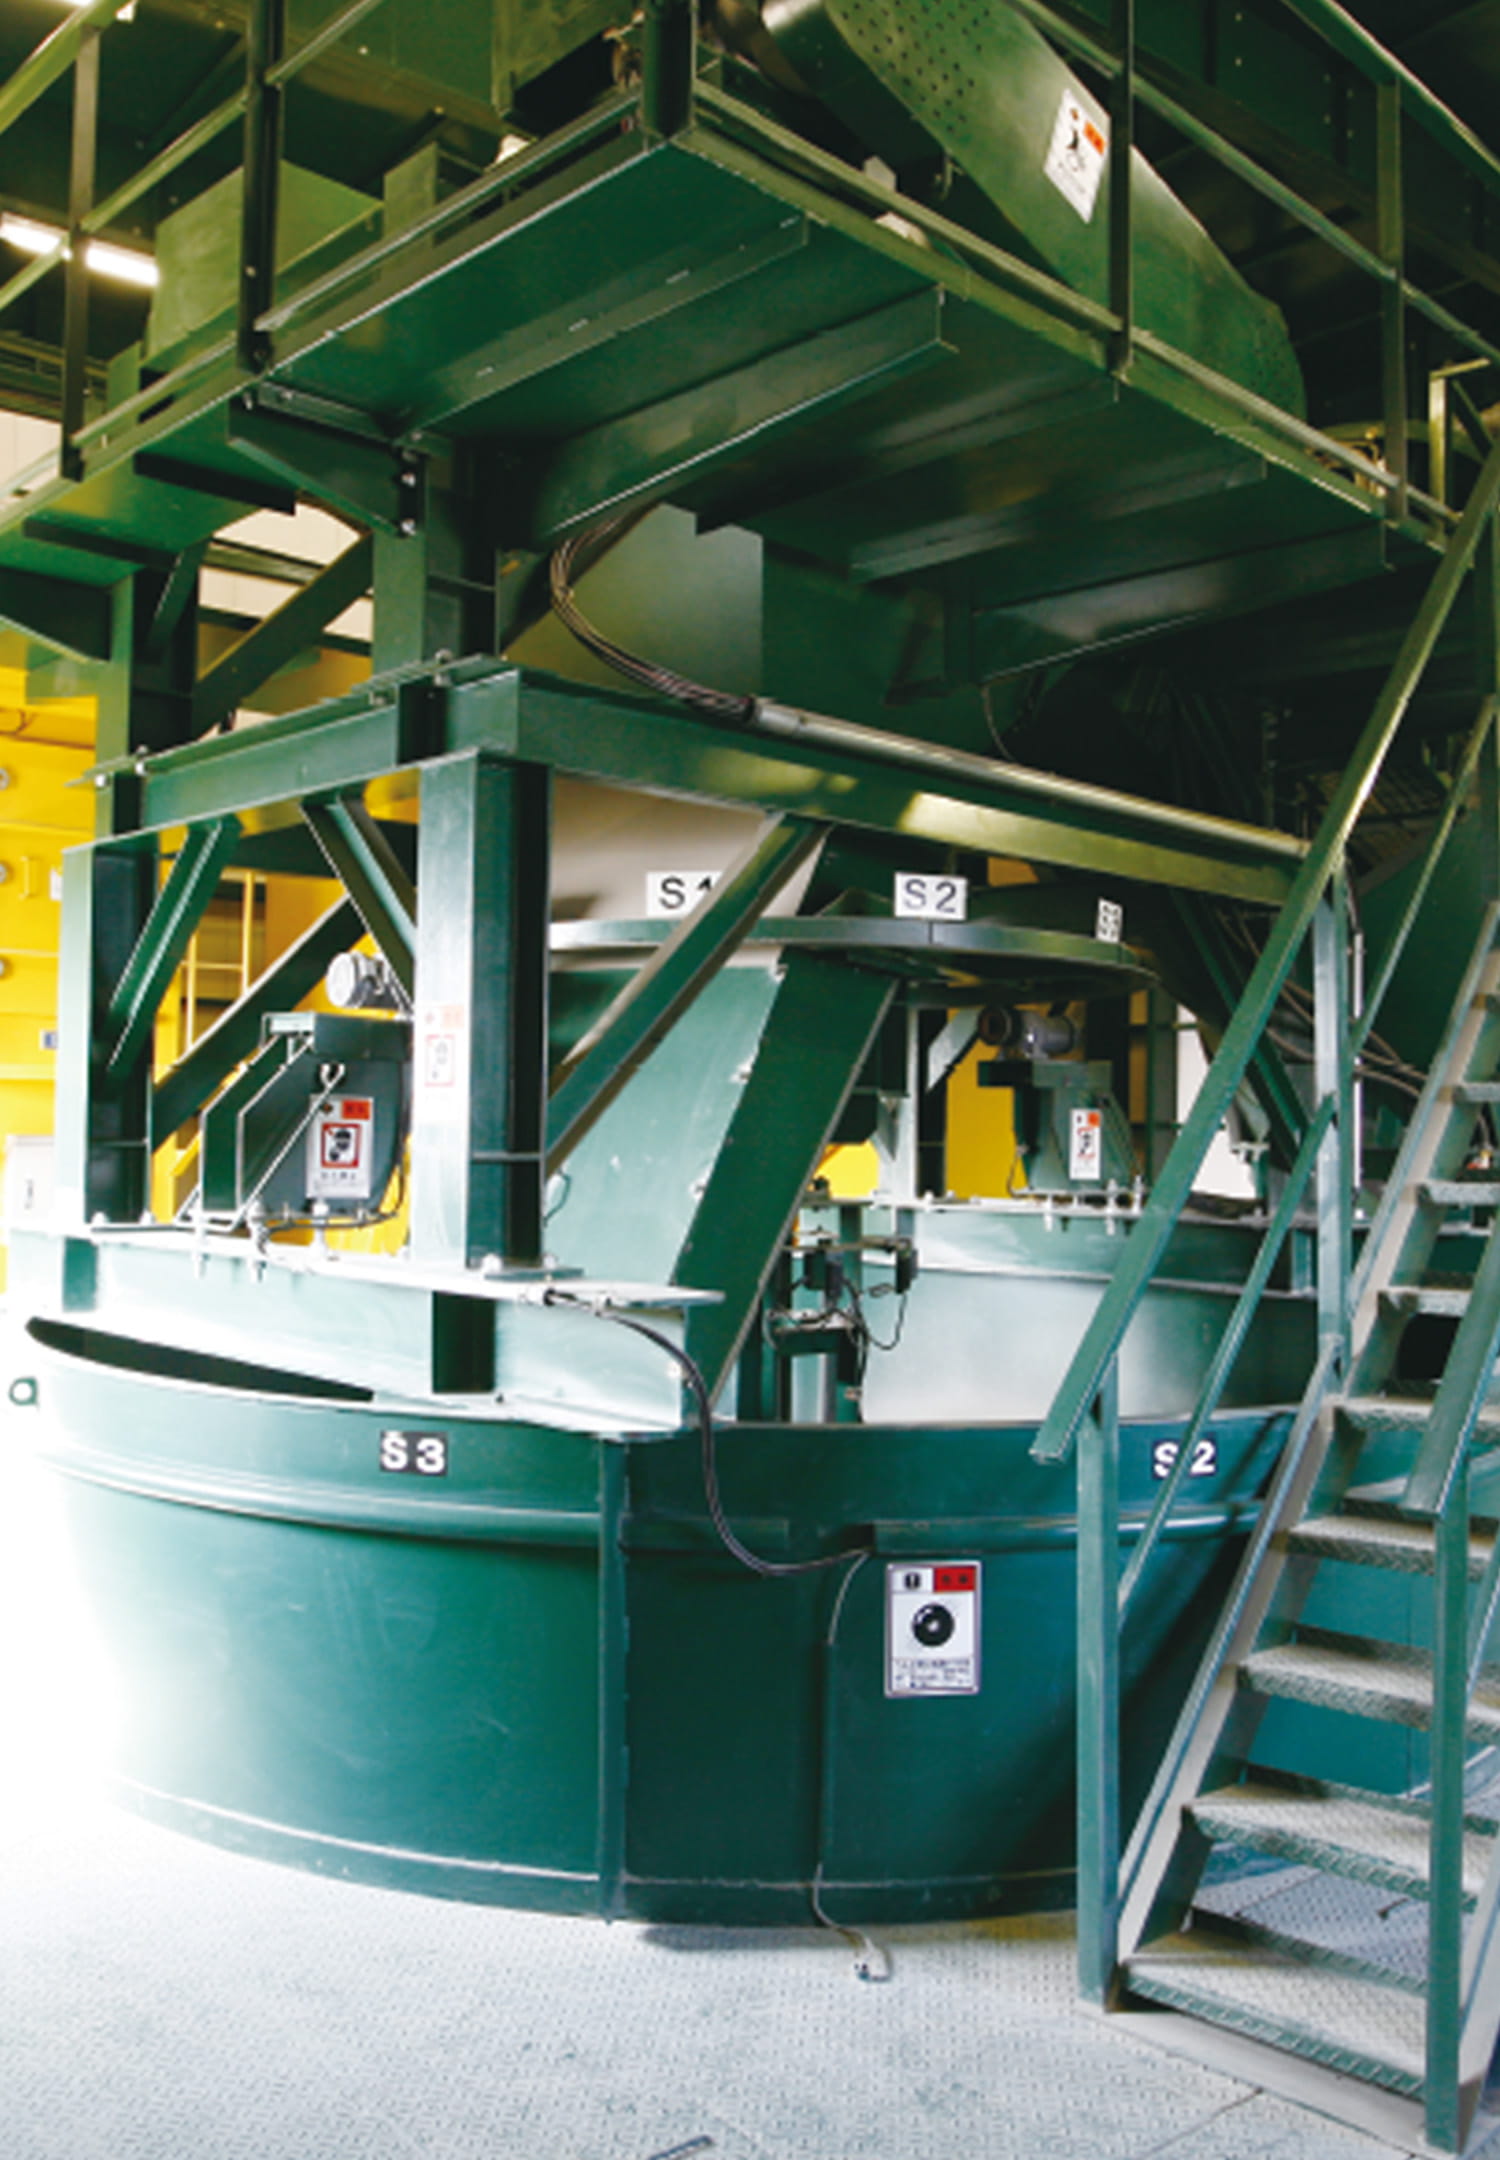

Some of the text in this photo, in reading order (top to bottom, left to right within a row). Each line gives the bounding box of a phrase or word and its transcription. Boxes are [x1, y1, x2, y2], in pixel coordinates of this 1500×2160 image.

[906, 879, 956, 912] S2
[382, 1437, 444, 1473] S3
[1155, 1441, 1215, 1477] S2
